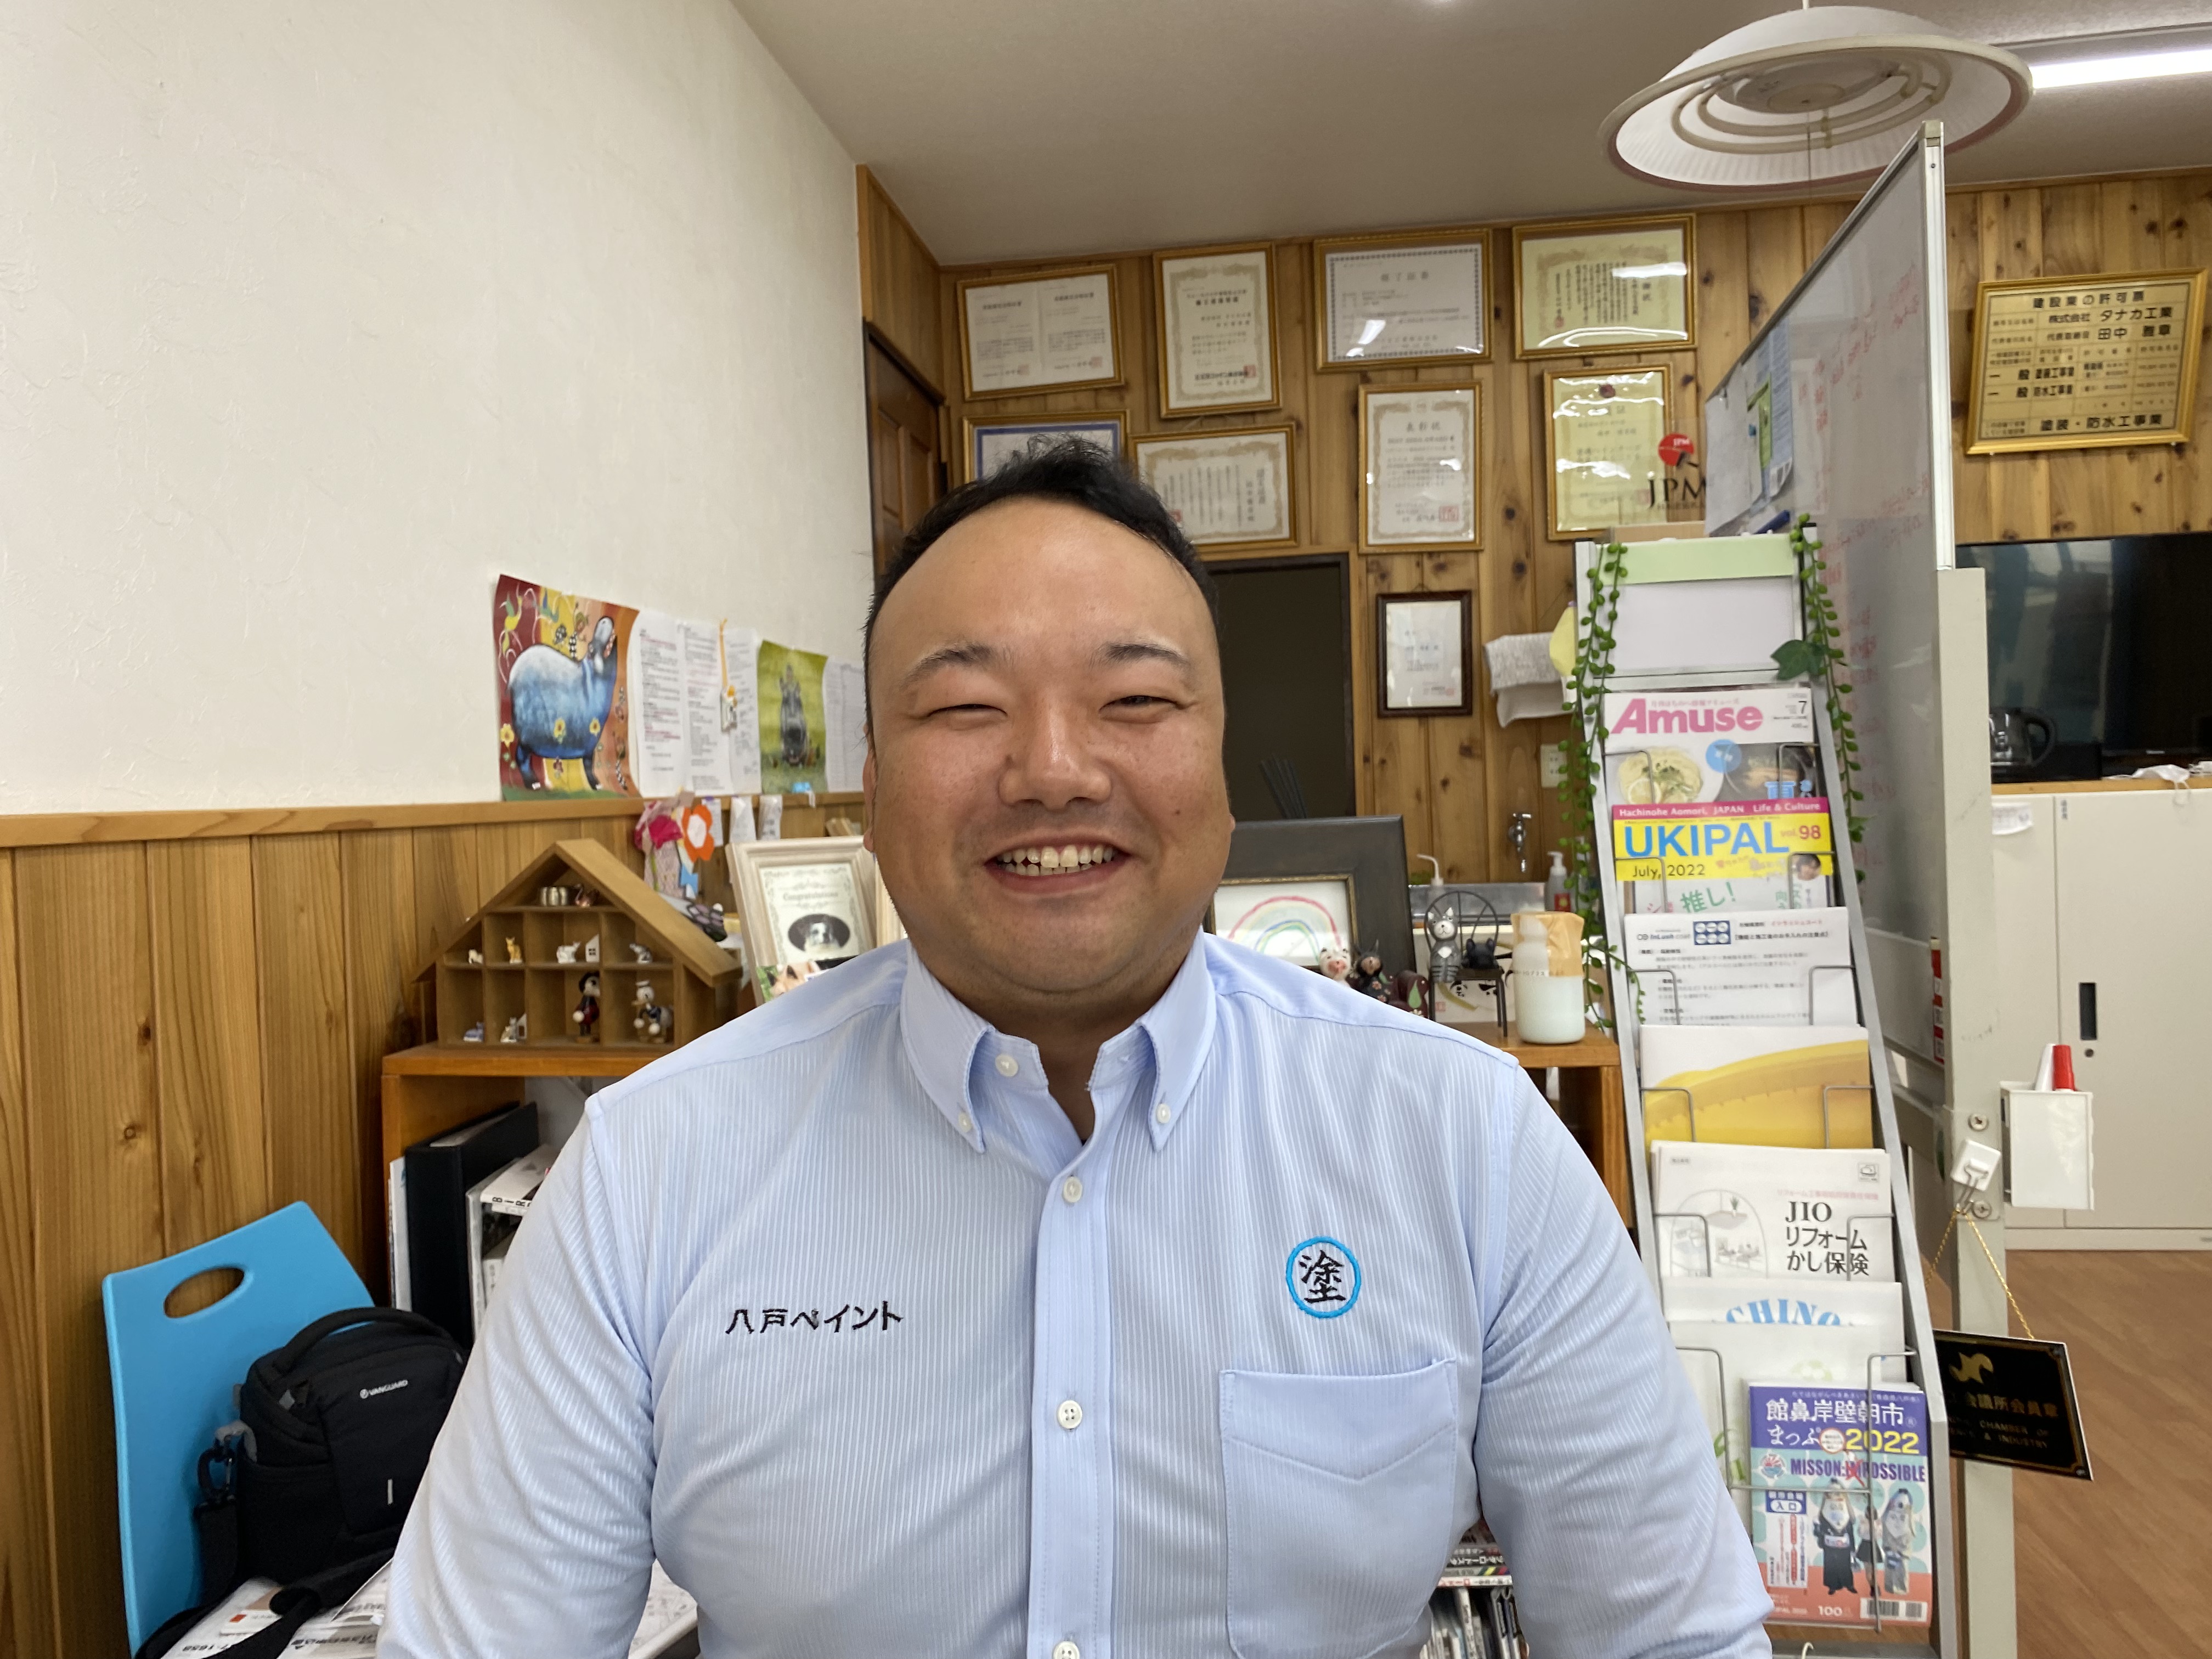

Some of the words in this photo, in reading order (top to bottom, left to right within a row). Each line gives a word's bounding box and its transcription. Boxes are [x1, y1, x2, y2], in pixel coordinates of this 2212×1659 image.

[1611, 698, 1763, 734] Amuse
[1798, 701, 1807, 714] 7
[1713, 805, 1744, 814] JAPAN
[1785, 802, 1820, 811] Culture
[1625, 822, 1789, 857] UKIPAL
[1633, 865, 1662, 879] July,
[1668, 864, 1705, 876] 2022
[1785, 1201, 1832, 1222] JIO
[1787, 1227, 1867, 1250] リフォーム
[1787, 1250, 1869, 1276] かし保険
[1299, 1250, 1346, 1304] 塗
[725, 1300, 904, 1334] 八戸ペイント
[1767, 1398, 1904, 1426] 館鼻岸壁朝市
[1768, 1424, 1821, 1446] まっぷ
[1846, 1429, 1919, 1454] 2022
